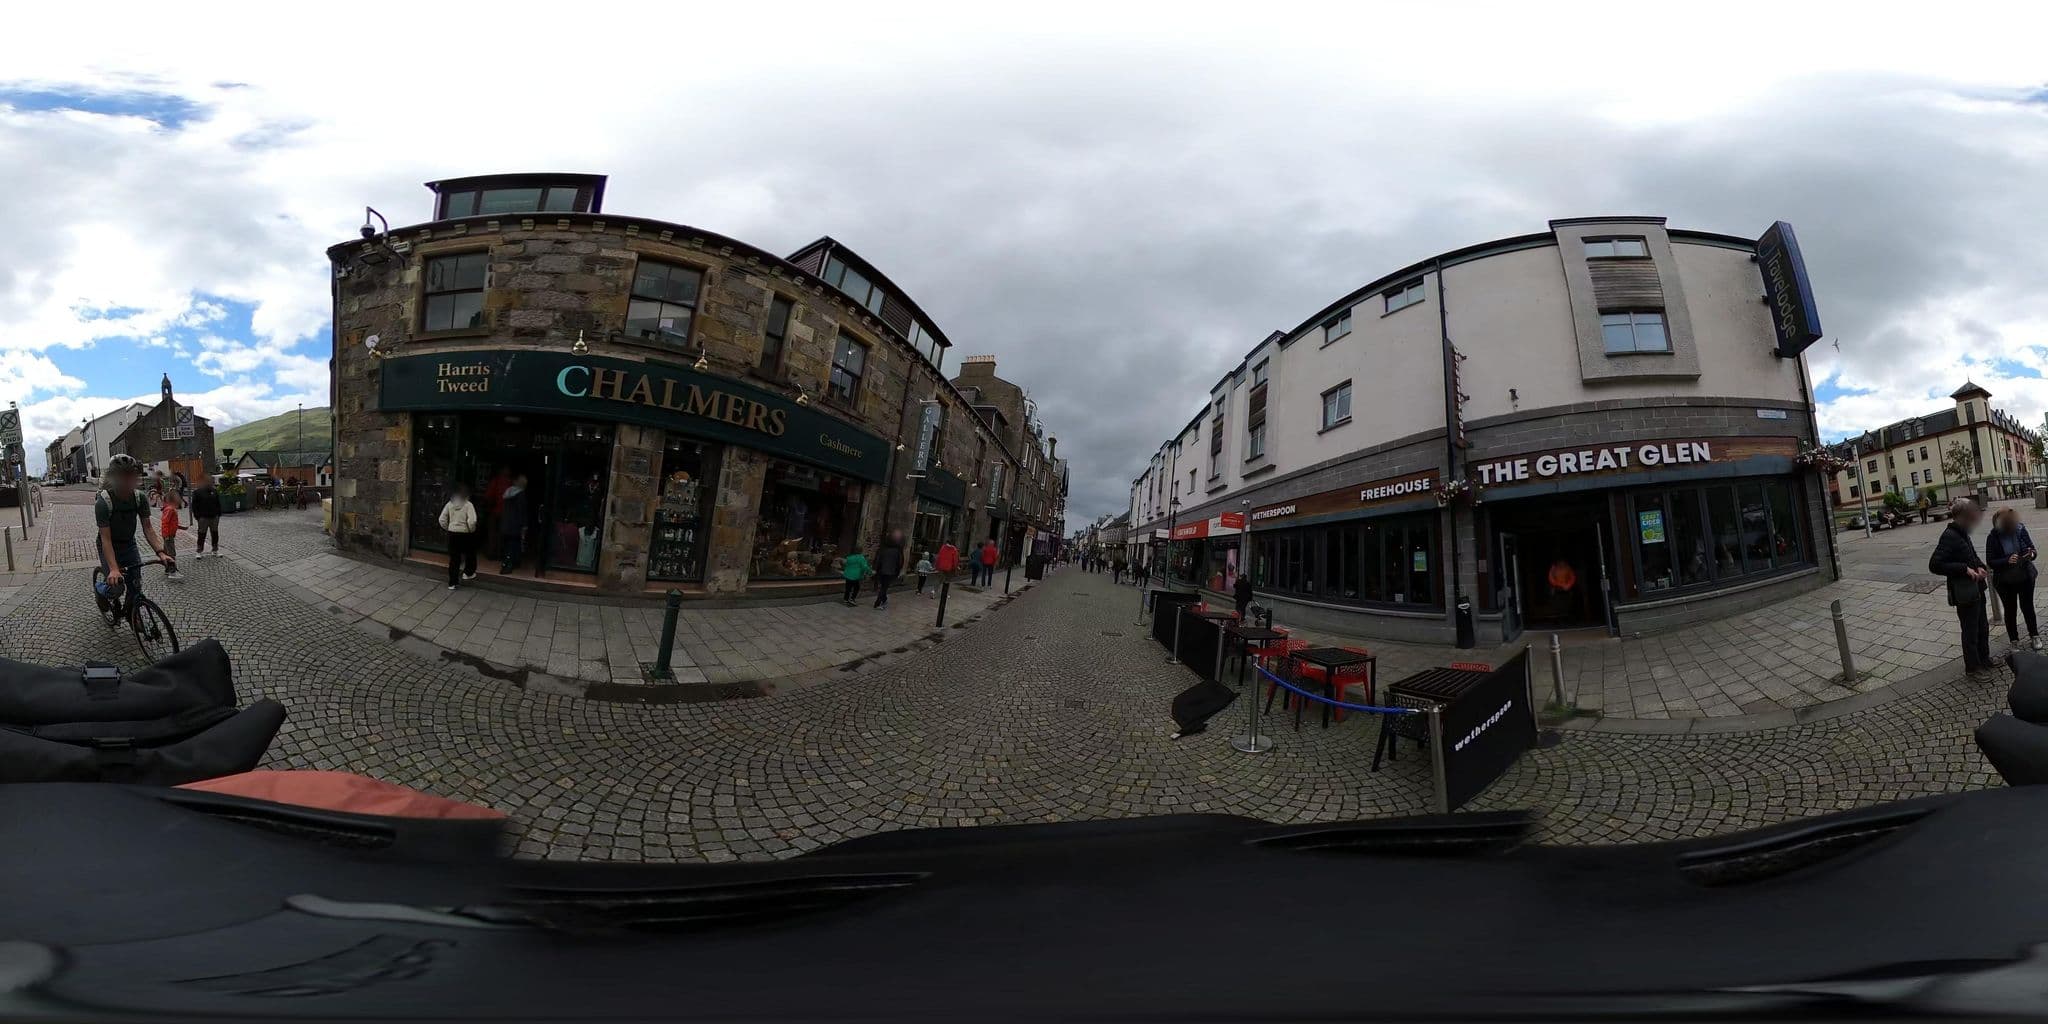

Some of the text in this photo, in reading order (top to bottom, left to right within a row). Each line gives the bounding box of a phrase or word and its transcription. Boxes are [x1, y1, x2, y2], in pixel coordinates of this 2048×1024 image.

[1767, 249, 1797, 338] Travelodge
[436, 378, 489, 393] Tweed
[438, 361, 490, 377] Harris
[556, 365, 787, 437] CHALMERS
[819, 432, 863, 459] Cashmere
[917, 406, 932, 468] GALLERY
[1477, 441, 1712, 485] THE GREAT GLEN
[1360, 478, 1430, 501] FREEHOUSE
[1252, 504, 1296, 521] WETHERSPOON
[1455, 700, 1512, 751] wetherspoon
